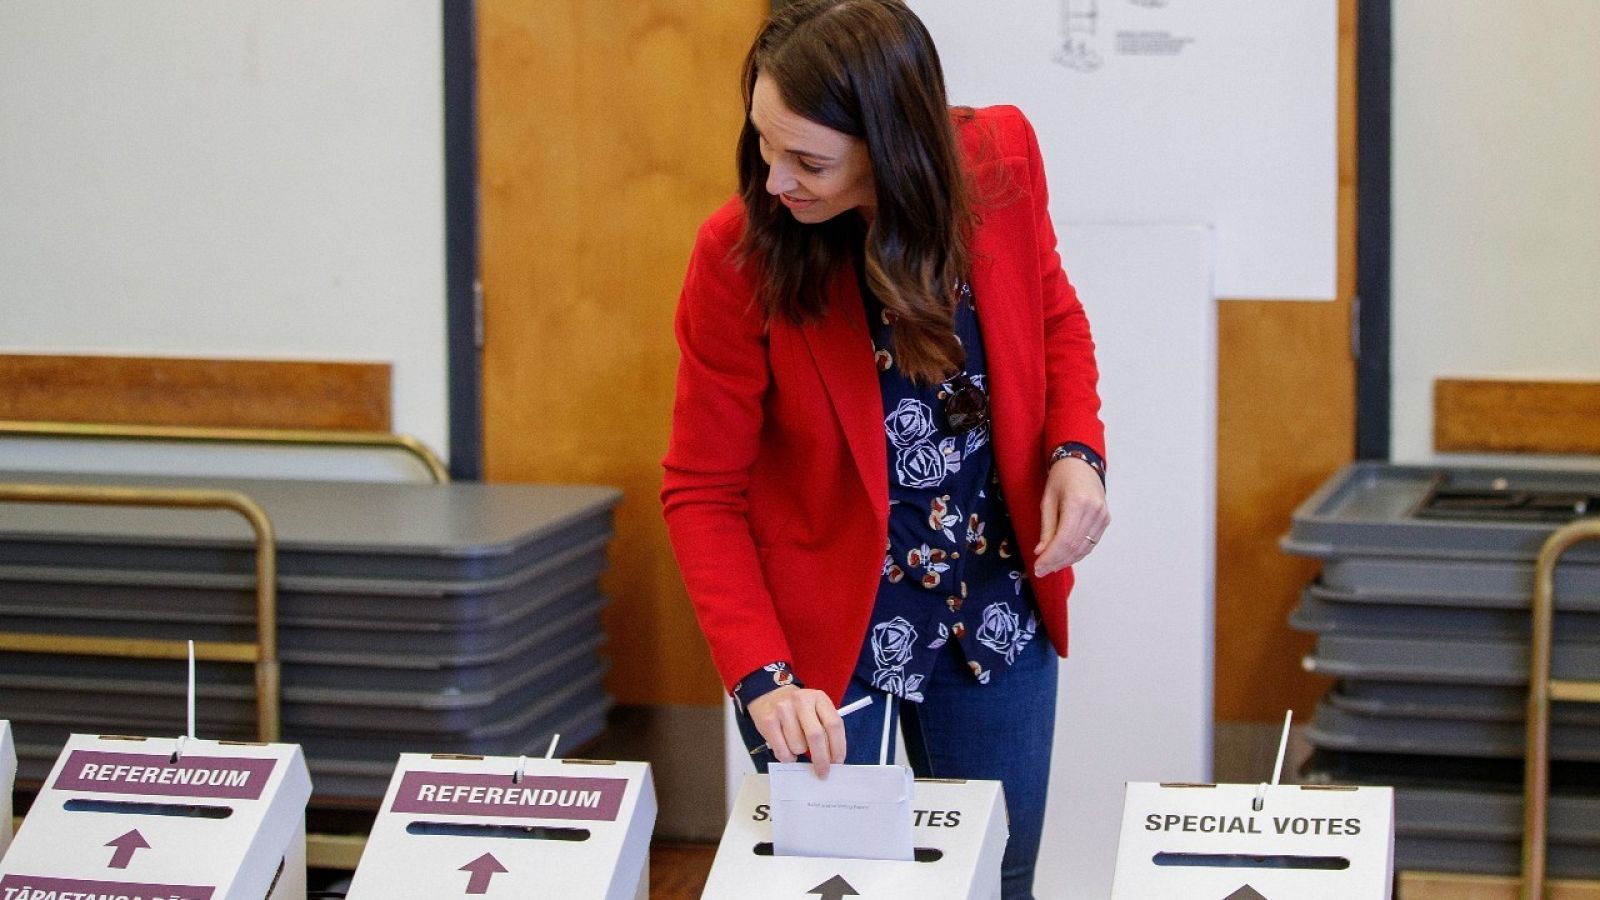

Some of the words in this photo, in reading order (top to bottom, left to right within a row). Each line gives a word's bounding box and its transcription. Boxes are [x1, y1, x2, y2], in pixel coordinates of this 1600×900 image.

[79, 763, 251, 787] REFERENDUM
[416, 784, 603, 808] REFERENDUM
[913, 809, 962, 828] TES
[1144, 814, 1262, 834] SPECIAL
[1272, 816, 1362, 836] VOTES
